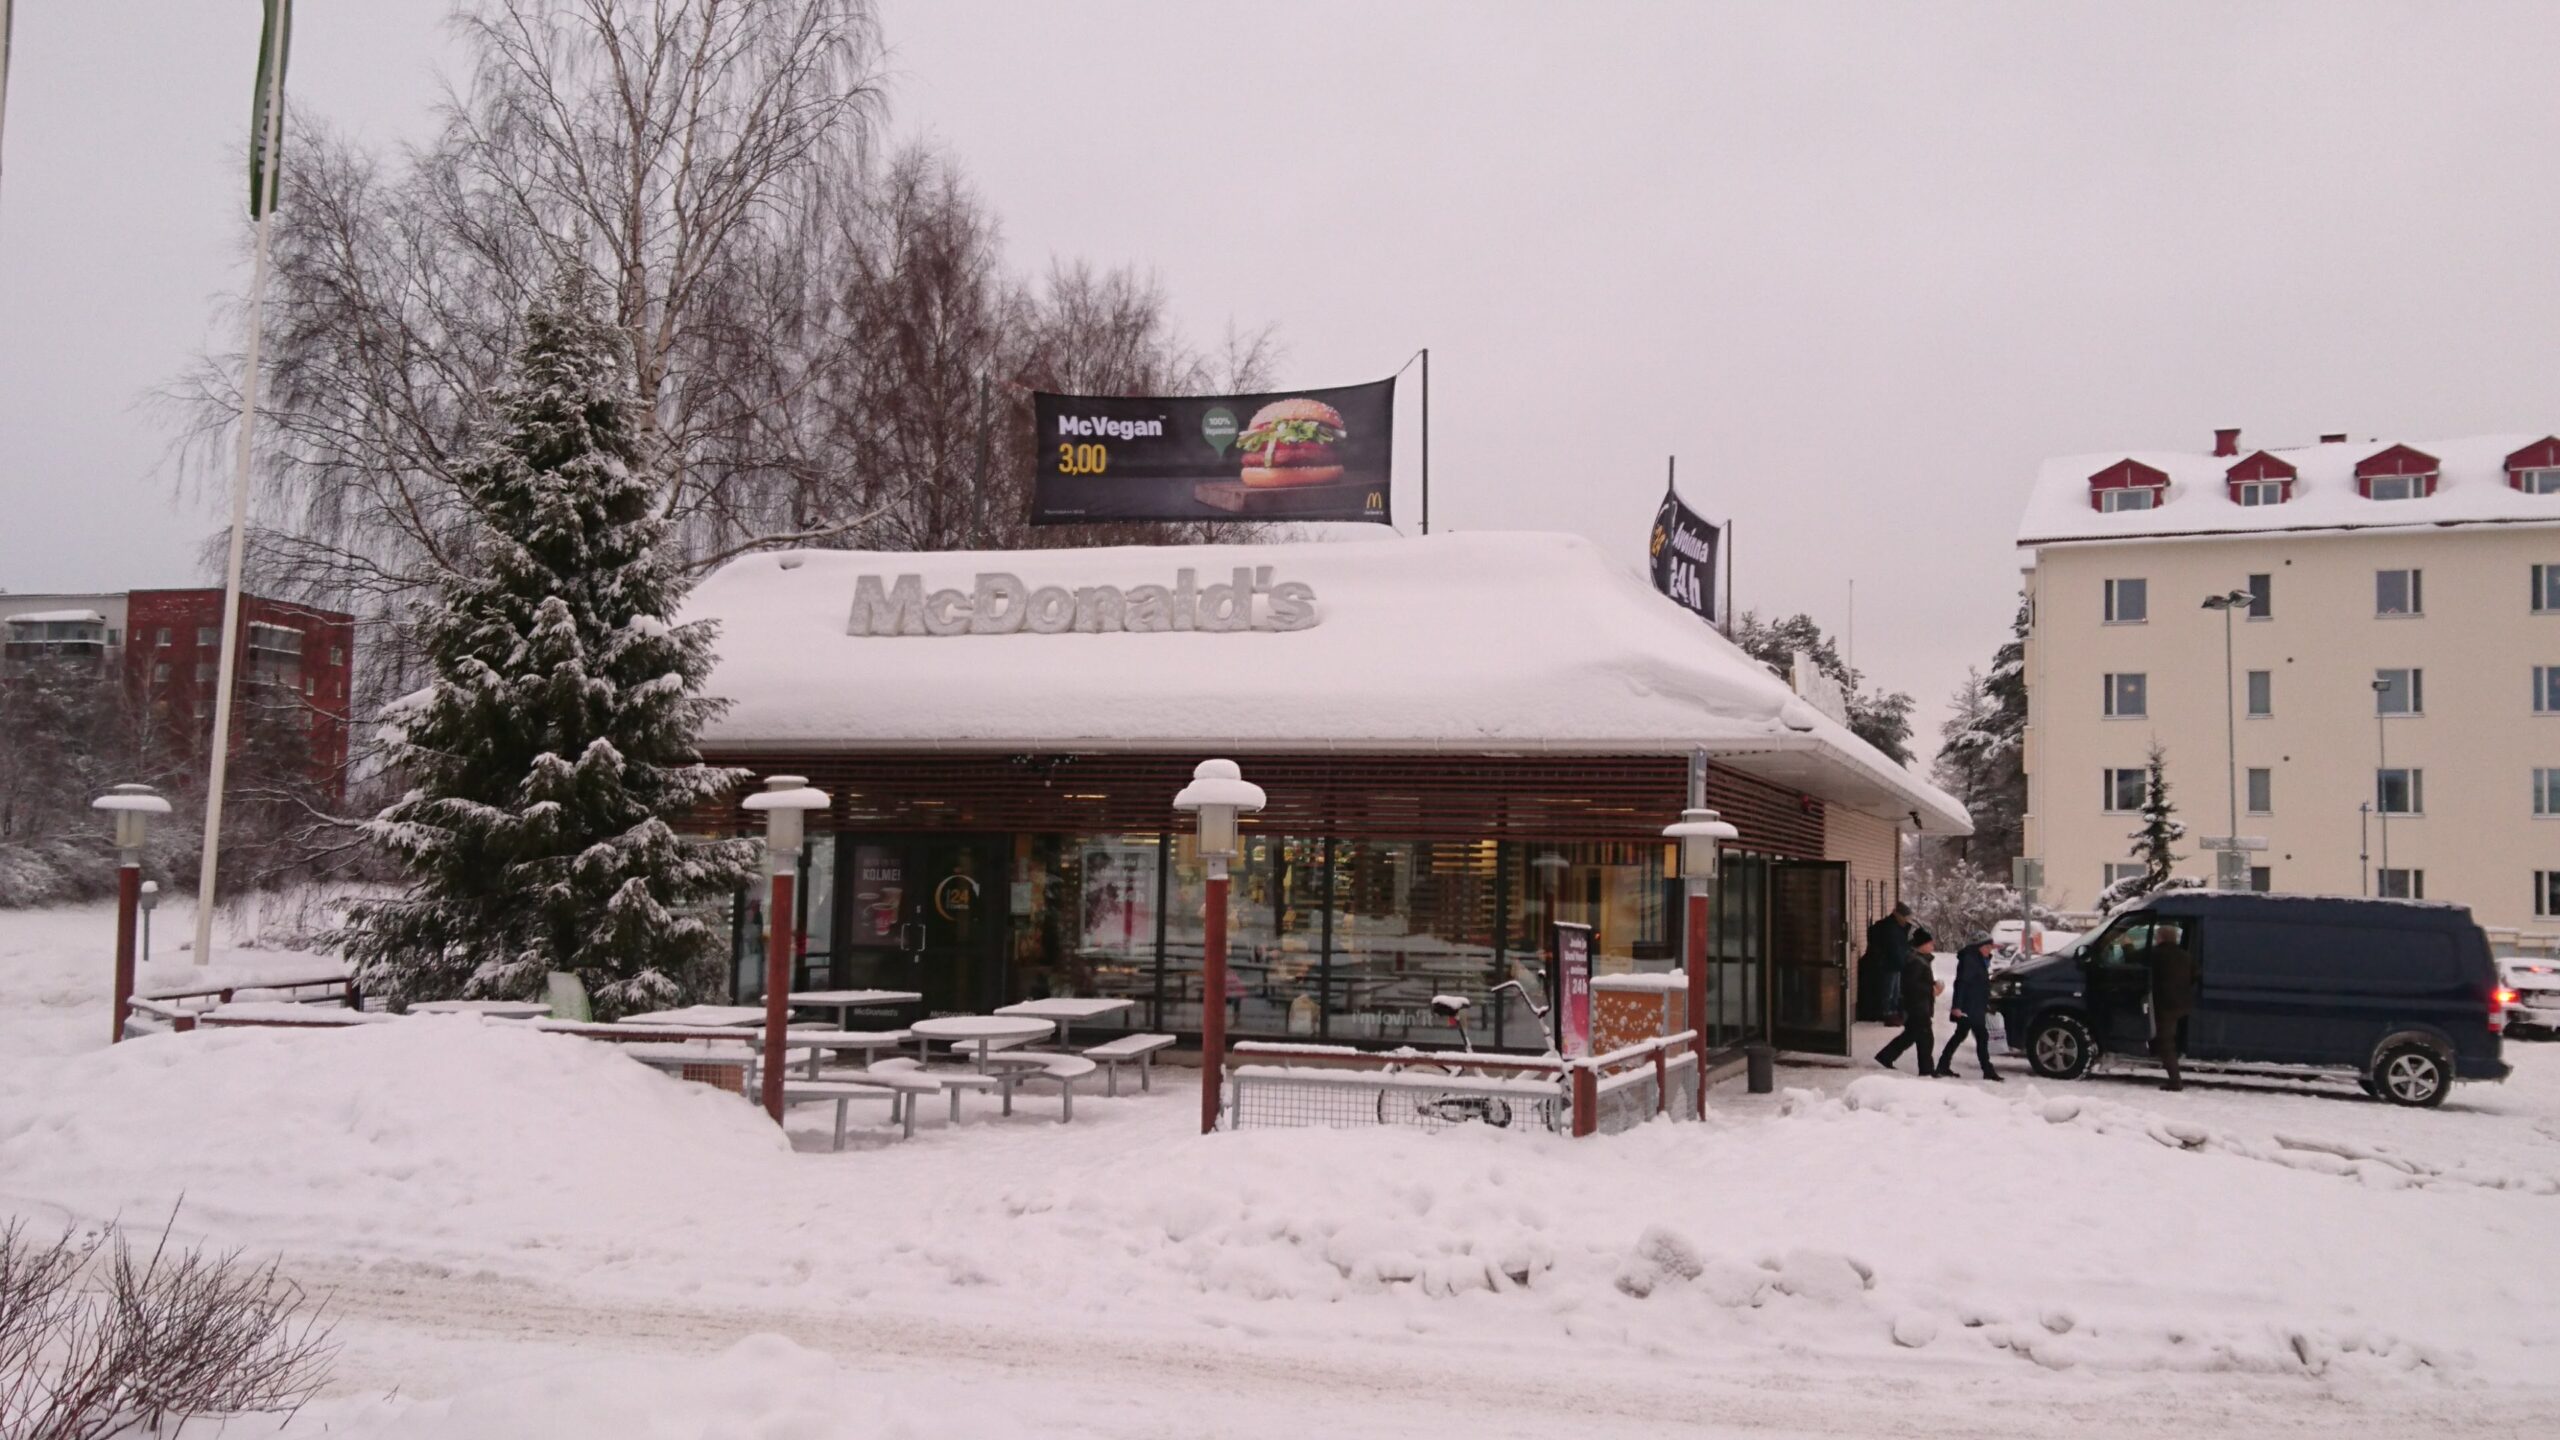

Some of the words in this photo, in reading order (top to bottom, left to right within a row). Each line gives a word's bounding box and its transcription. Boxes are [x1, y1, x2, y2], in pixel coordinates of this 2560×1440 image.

[1058, 443, 1107, 475] 3,00
[1672, 521, 1709, 563] Avoinna
[846, 565, 1319, 637] McDonald's
[951, 889, 969, 904] 24
